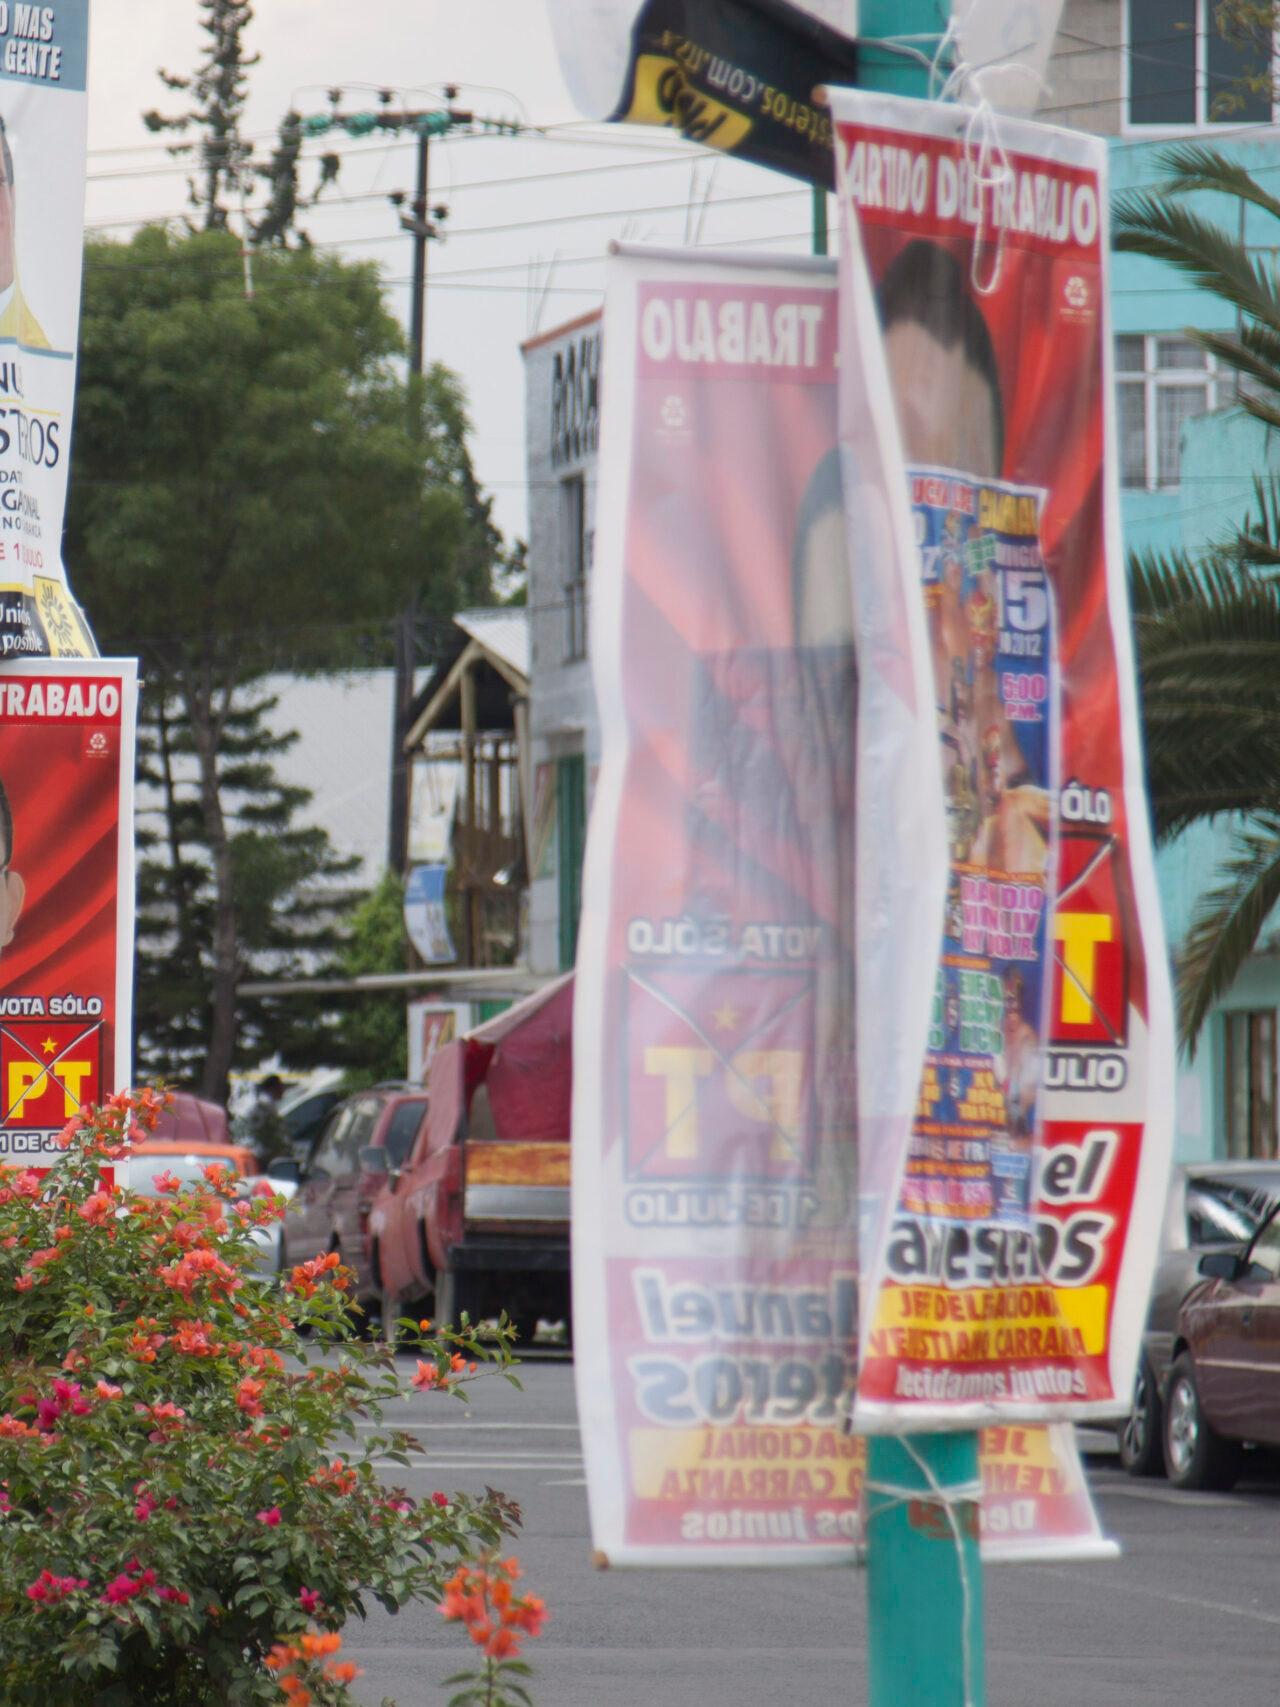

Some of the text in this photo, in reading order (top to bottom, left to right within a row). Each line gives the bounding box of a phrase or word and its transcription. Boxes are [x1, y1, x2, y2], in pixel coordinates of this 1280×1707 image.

[13, 4, 55, 42] MAS
[4, 38, 62, 80] GENTE
[1060, 782, 1112, 824] ÓLO
[50, 995, 102, 1015] SÓLO
[8, 1061, 92, 1119] PT
[1045, 1056, 1125, 1090] ULIO
[15, 1136, 39, 1151] DE
